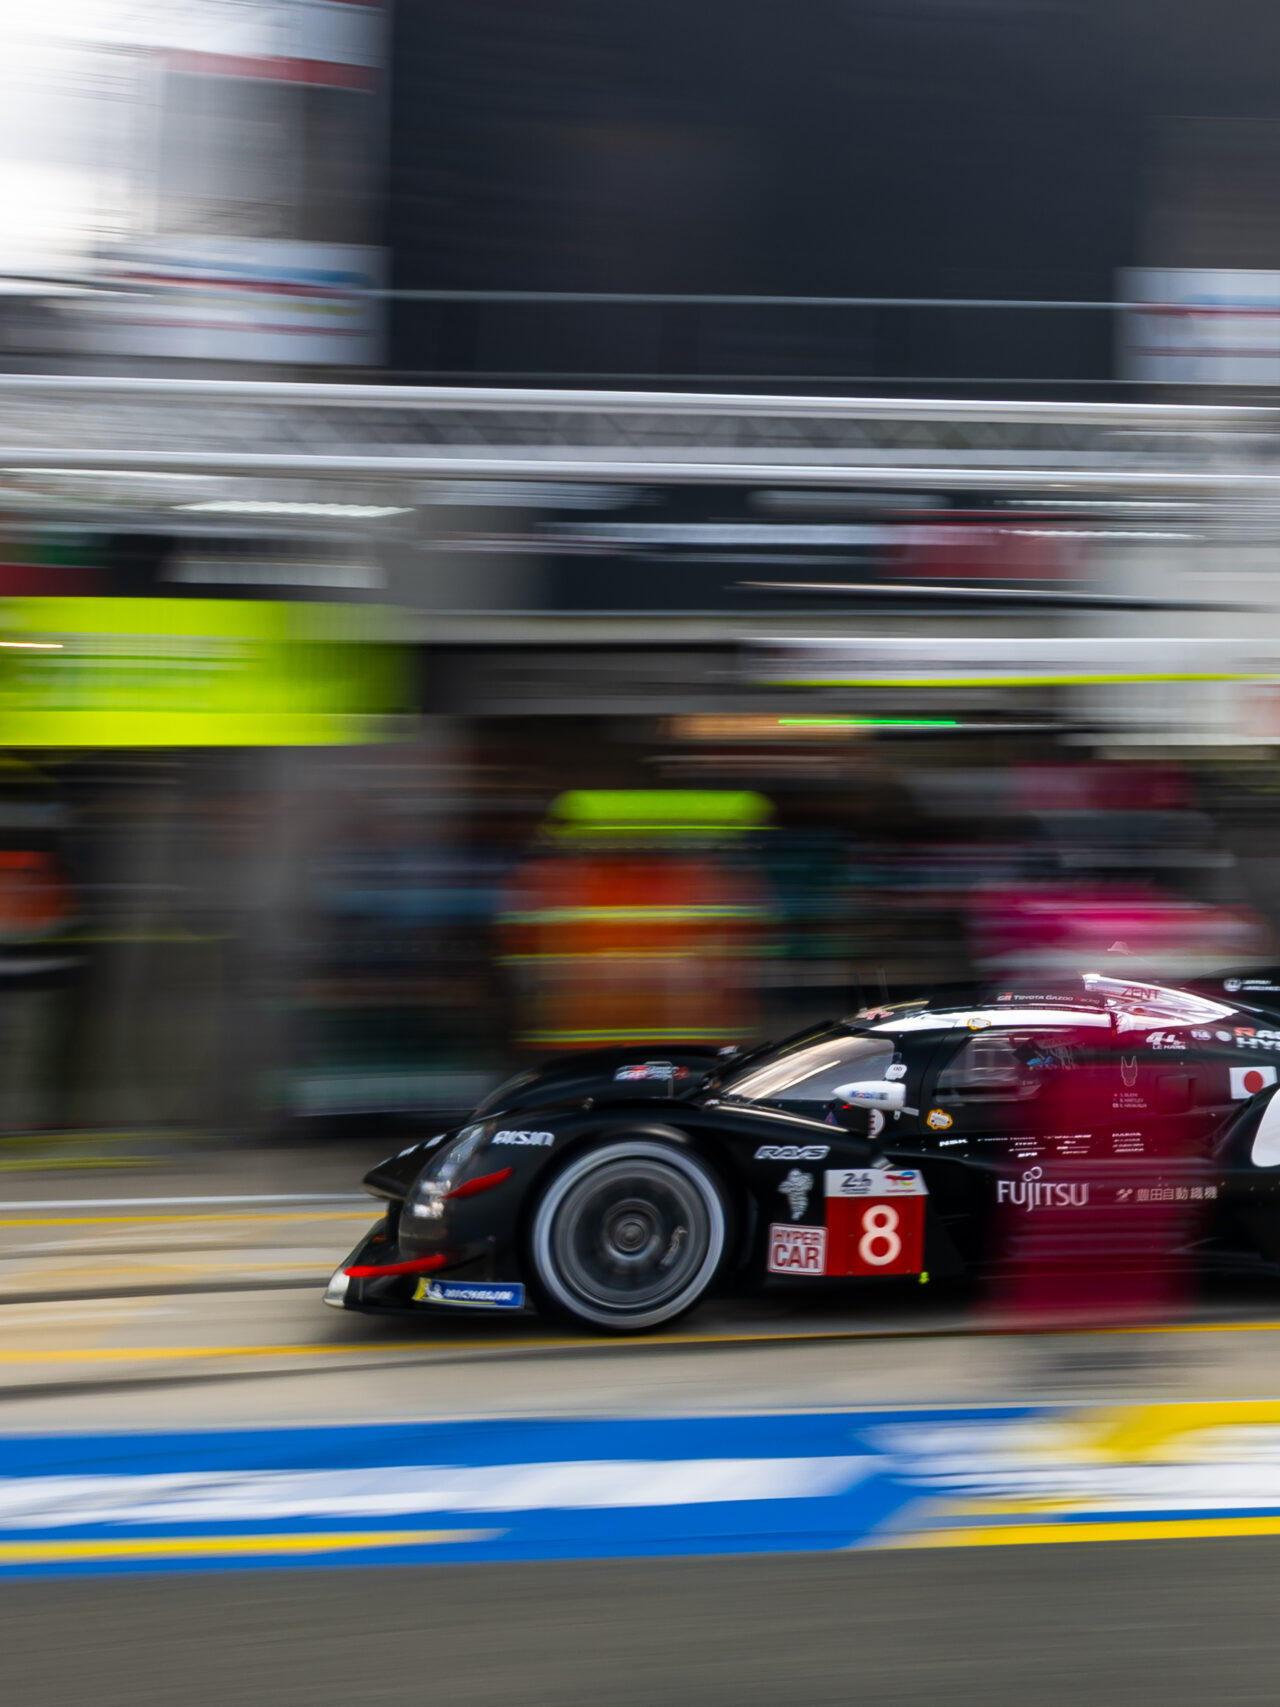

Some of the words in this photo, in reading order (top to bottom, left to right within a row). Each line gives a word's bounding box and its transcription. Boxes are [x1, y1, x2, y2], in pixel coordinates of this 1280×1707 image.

[1121, 986, 1161, 1000] ZENT
[491, 1130, 555, 1147] AISIN
[754, 1145, 831, 1160] RAYS
[997, 1176, 1090, 1213] FUJITSU
[775, 1230, 821, 1246] HYPER
[858, 1204, 902, 1267] 8
[773, 1244, 819, 1269] CAR
[444, 1288, 514, 1301] MICHELIN
